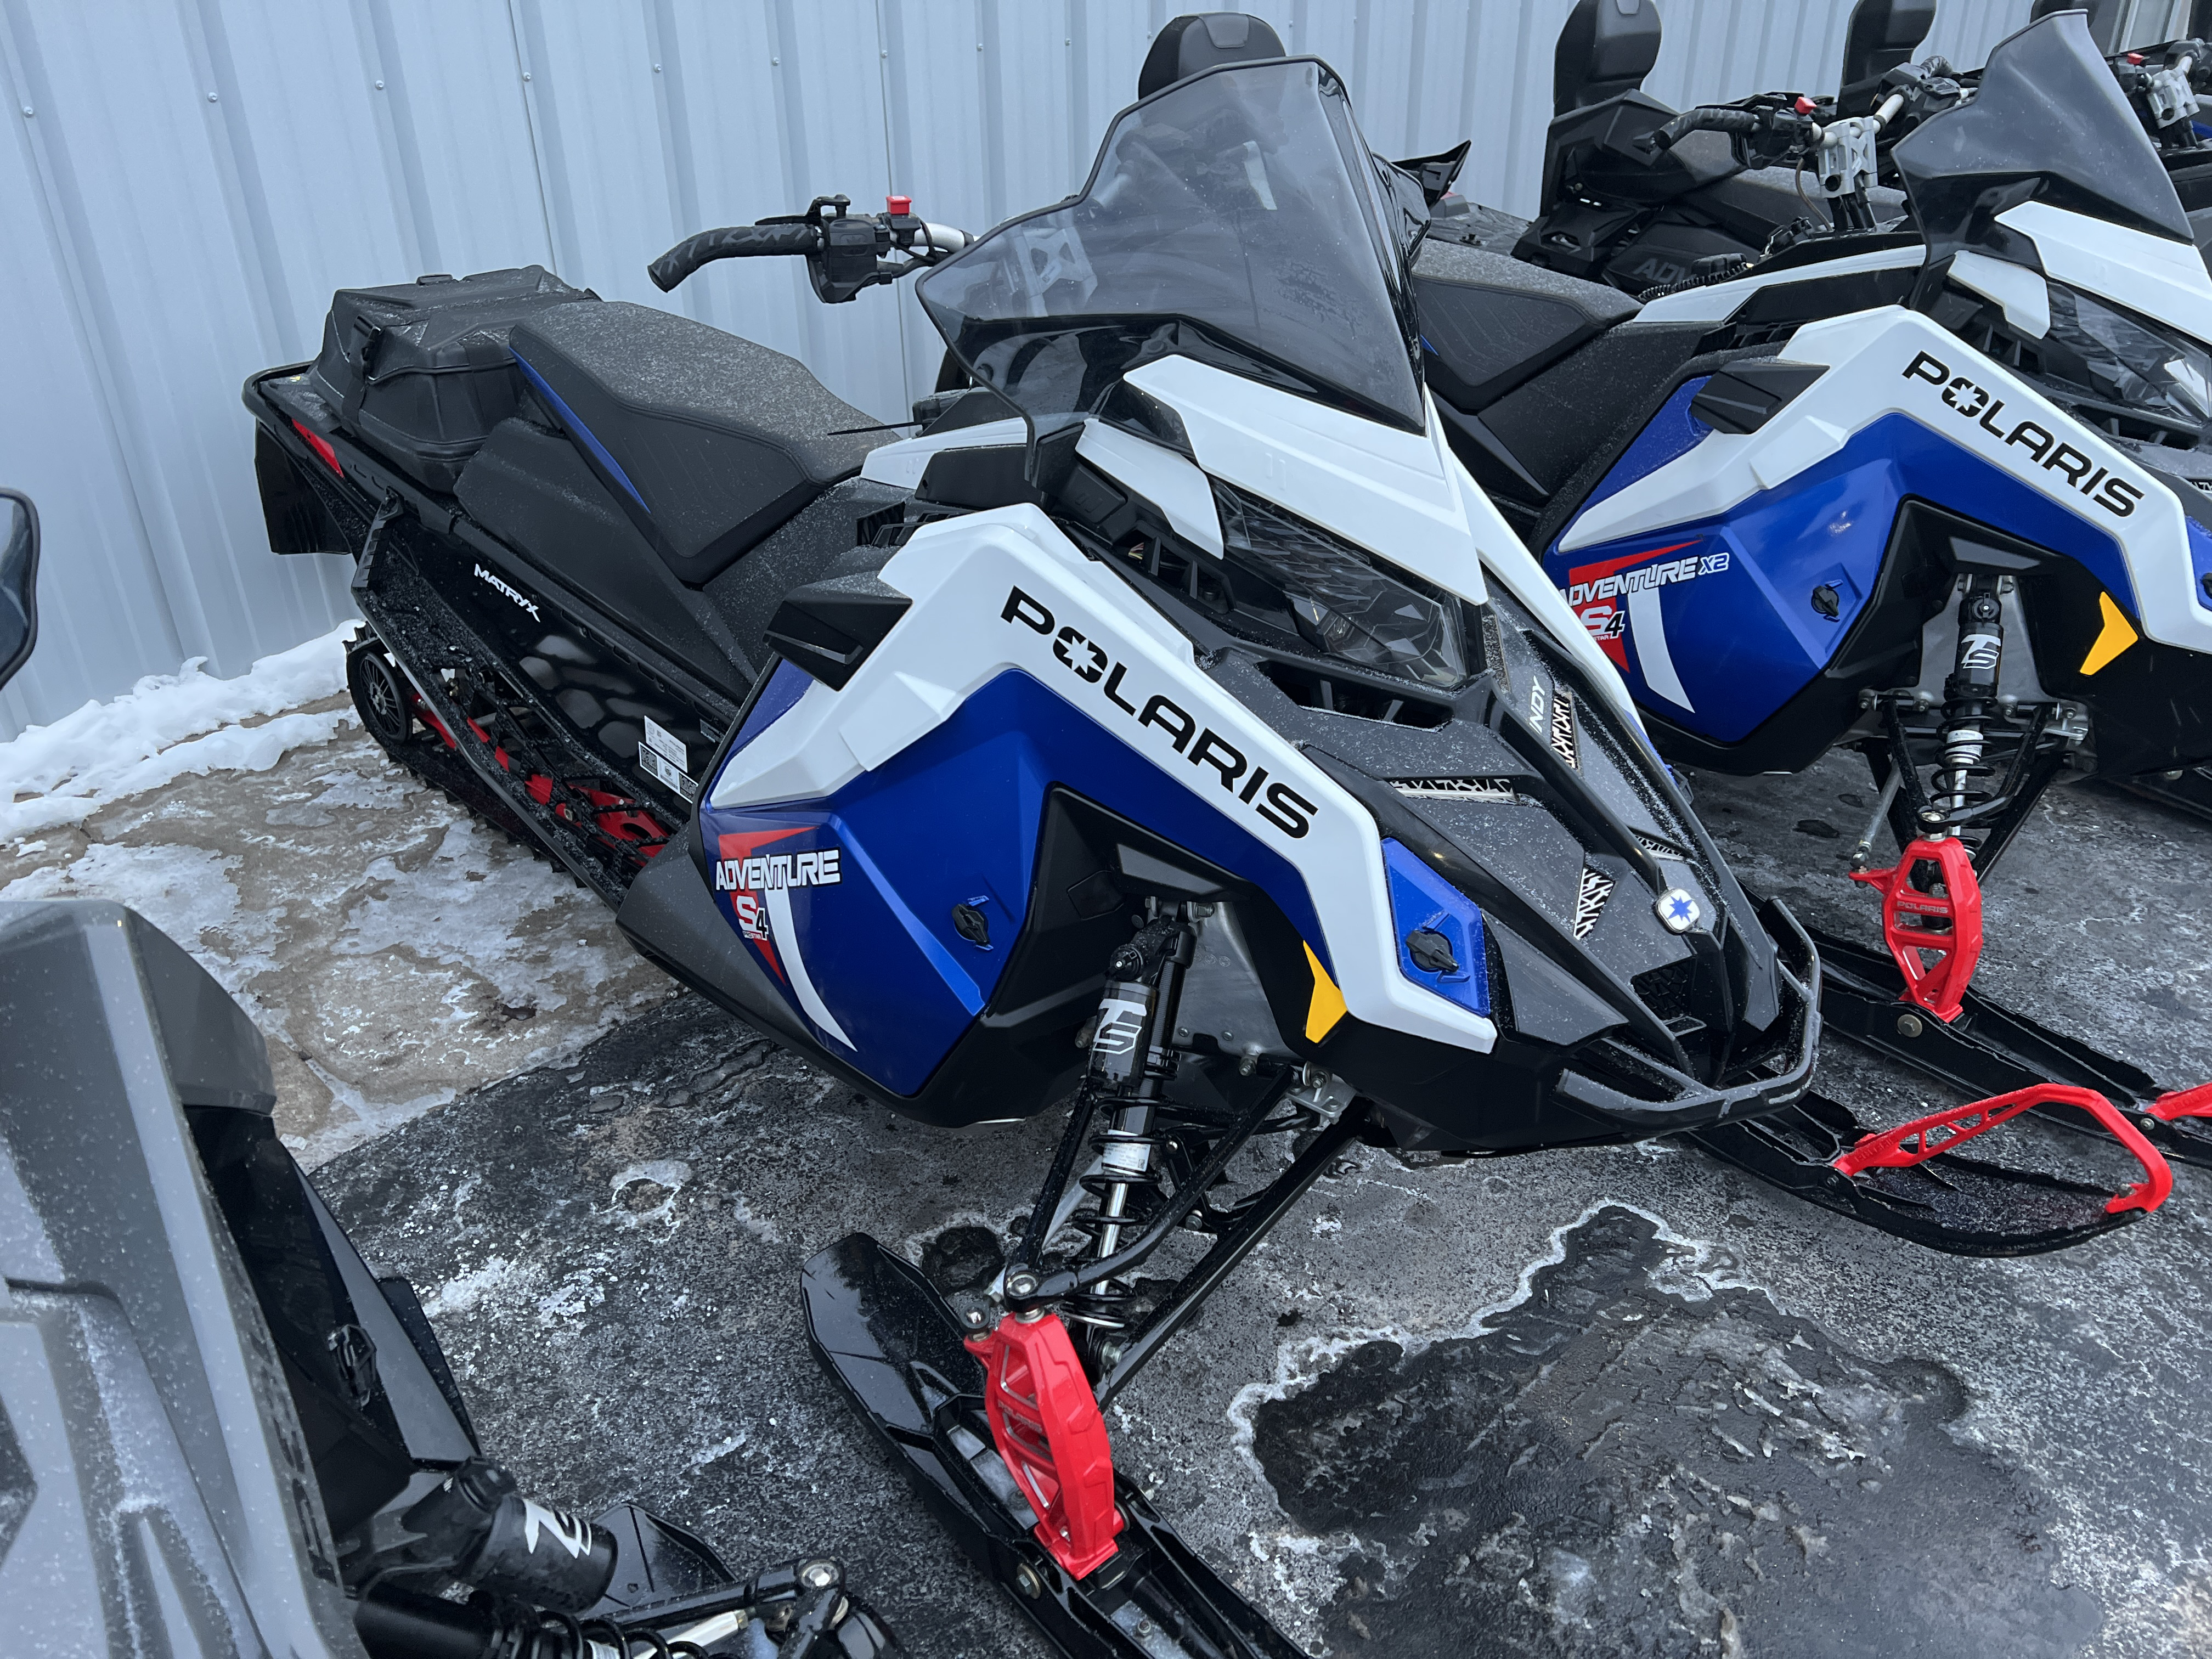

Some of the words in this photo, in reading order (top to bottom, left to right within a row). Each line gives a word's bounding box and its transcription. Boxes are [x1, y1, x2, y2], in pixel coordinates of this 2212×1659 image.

[1901, 351, 2145, 517] POLARIS
[474, 563, 540, 622] MATRYX
[1698, 552, 1730, 575] X2
[1000, 585, 1318, 839] POLARIS
[1529, 675, 1545, 735] INDY
[715, 849, 840, 890] ADVENTURE
[1897, 901, 1948, 913] POLARIS
